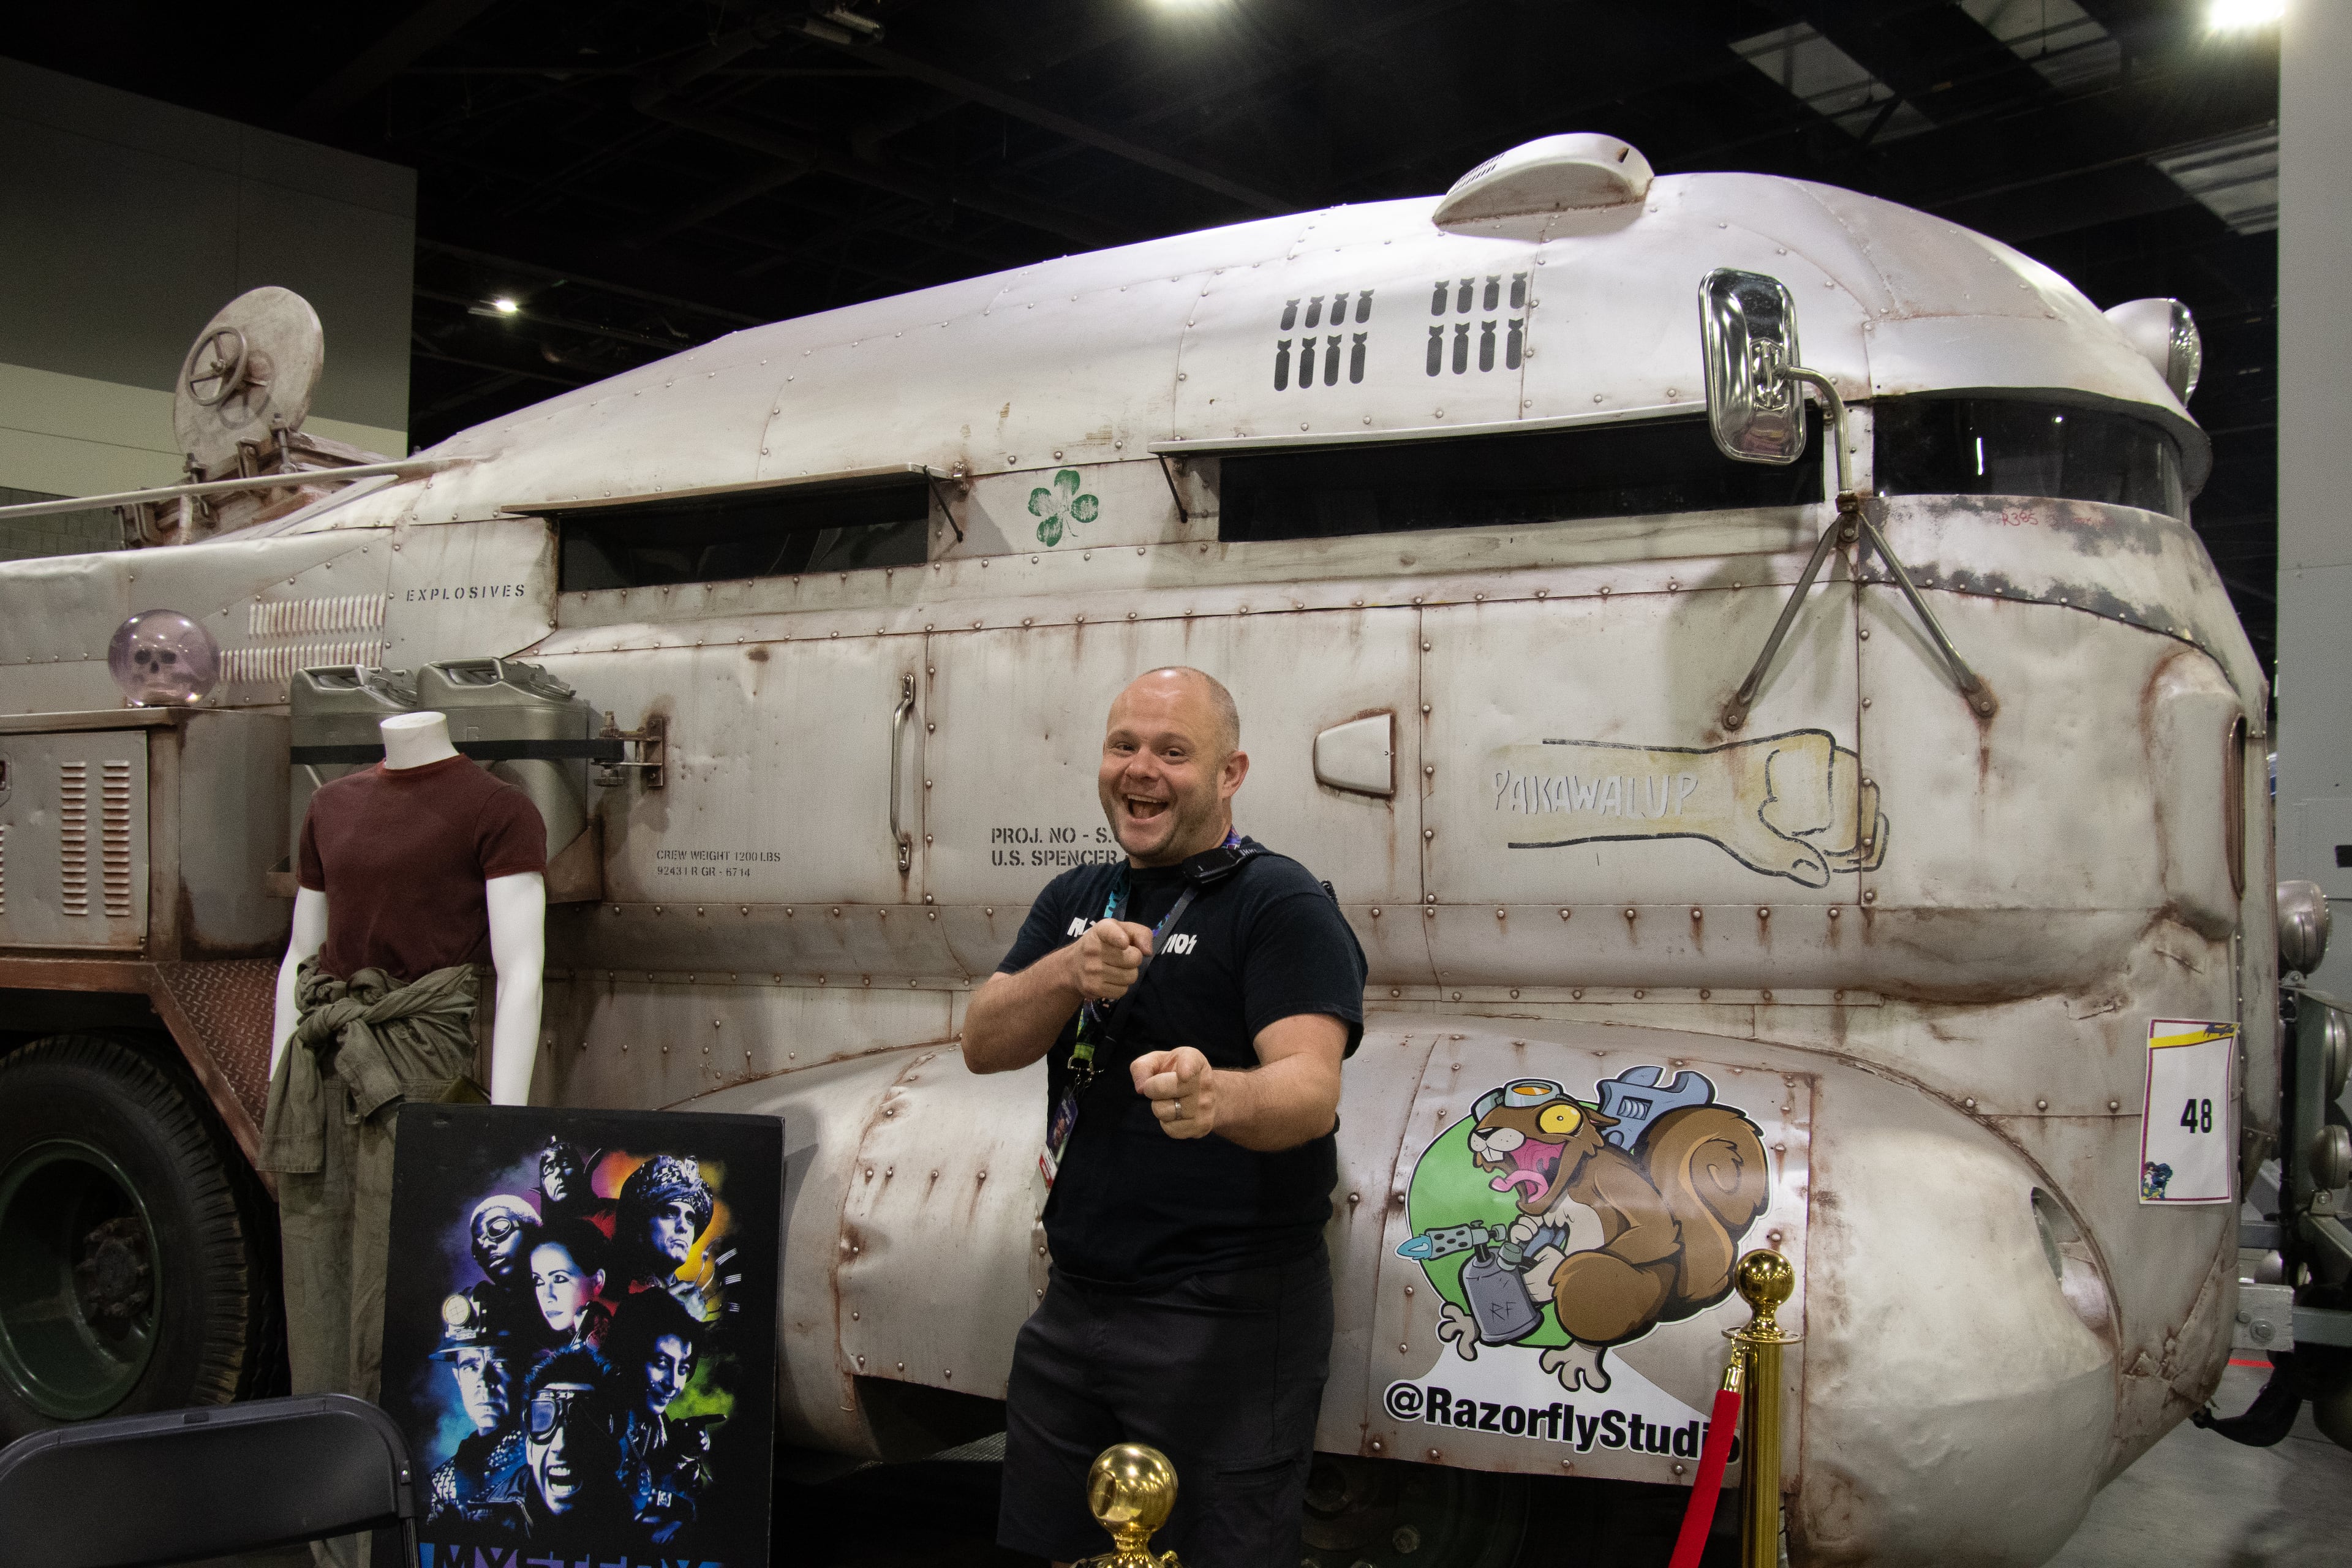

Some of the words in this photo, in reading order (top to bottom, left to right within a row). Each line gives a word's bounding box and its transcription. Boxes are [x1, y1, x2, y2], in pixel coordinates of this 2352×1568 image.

[406, 584, 524, 601] EXPLOSIVES
[1496, 770, 1698, 818] PAKAWALUP
[992, 827, 1042, 843] PROJ.
[1049, 827, 1076, 843] NO
[657, 850, 687, 860] CREW
[691, 850, 730, 861] WEIGHT
[734, 851, 758, 861] 1200
[760, 852, 781, 862] LBS
[992, 850, 1025, 866] U.S.
[1031, 850, 1117, 866] SPENCER
[691, 866, 698, 876] R
[701, 867, 716, 876] GR
[2180, 1099, 2212, 1134] 48
[1490, 1301, 1517, 1322] RF
